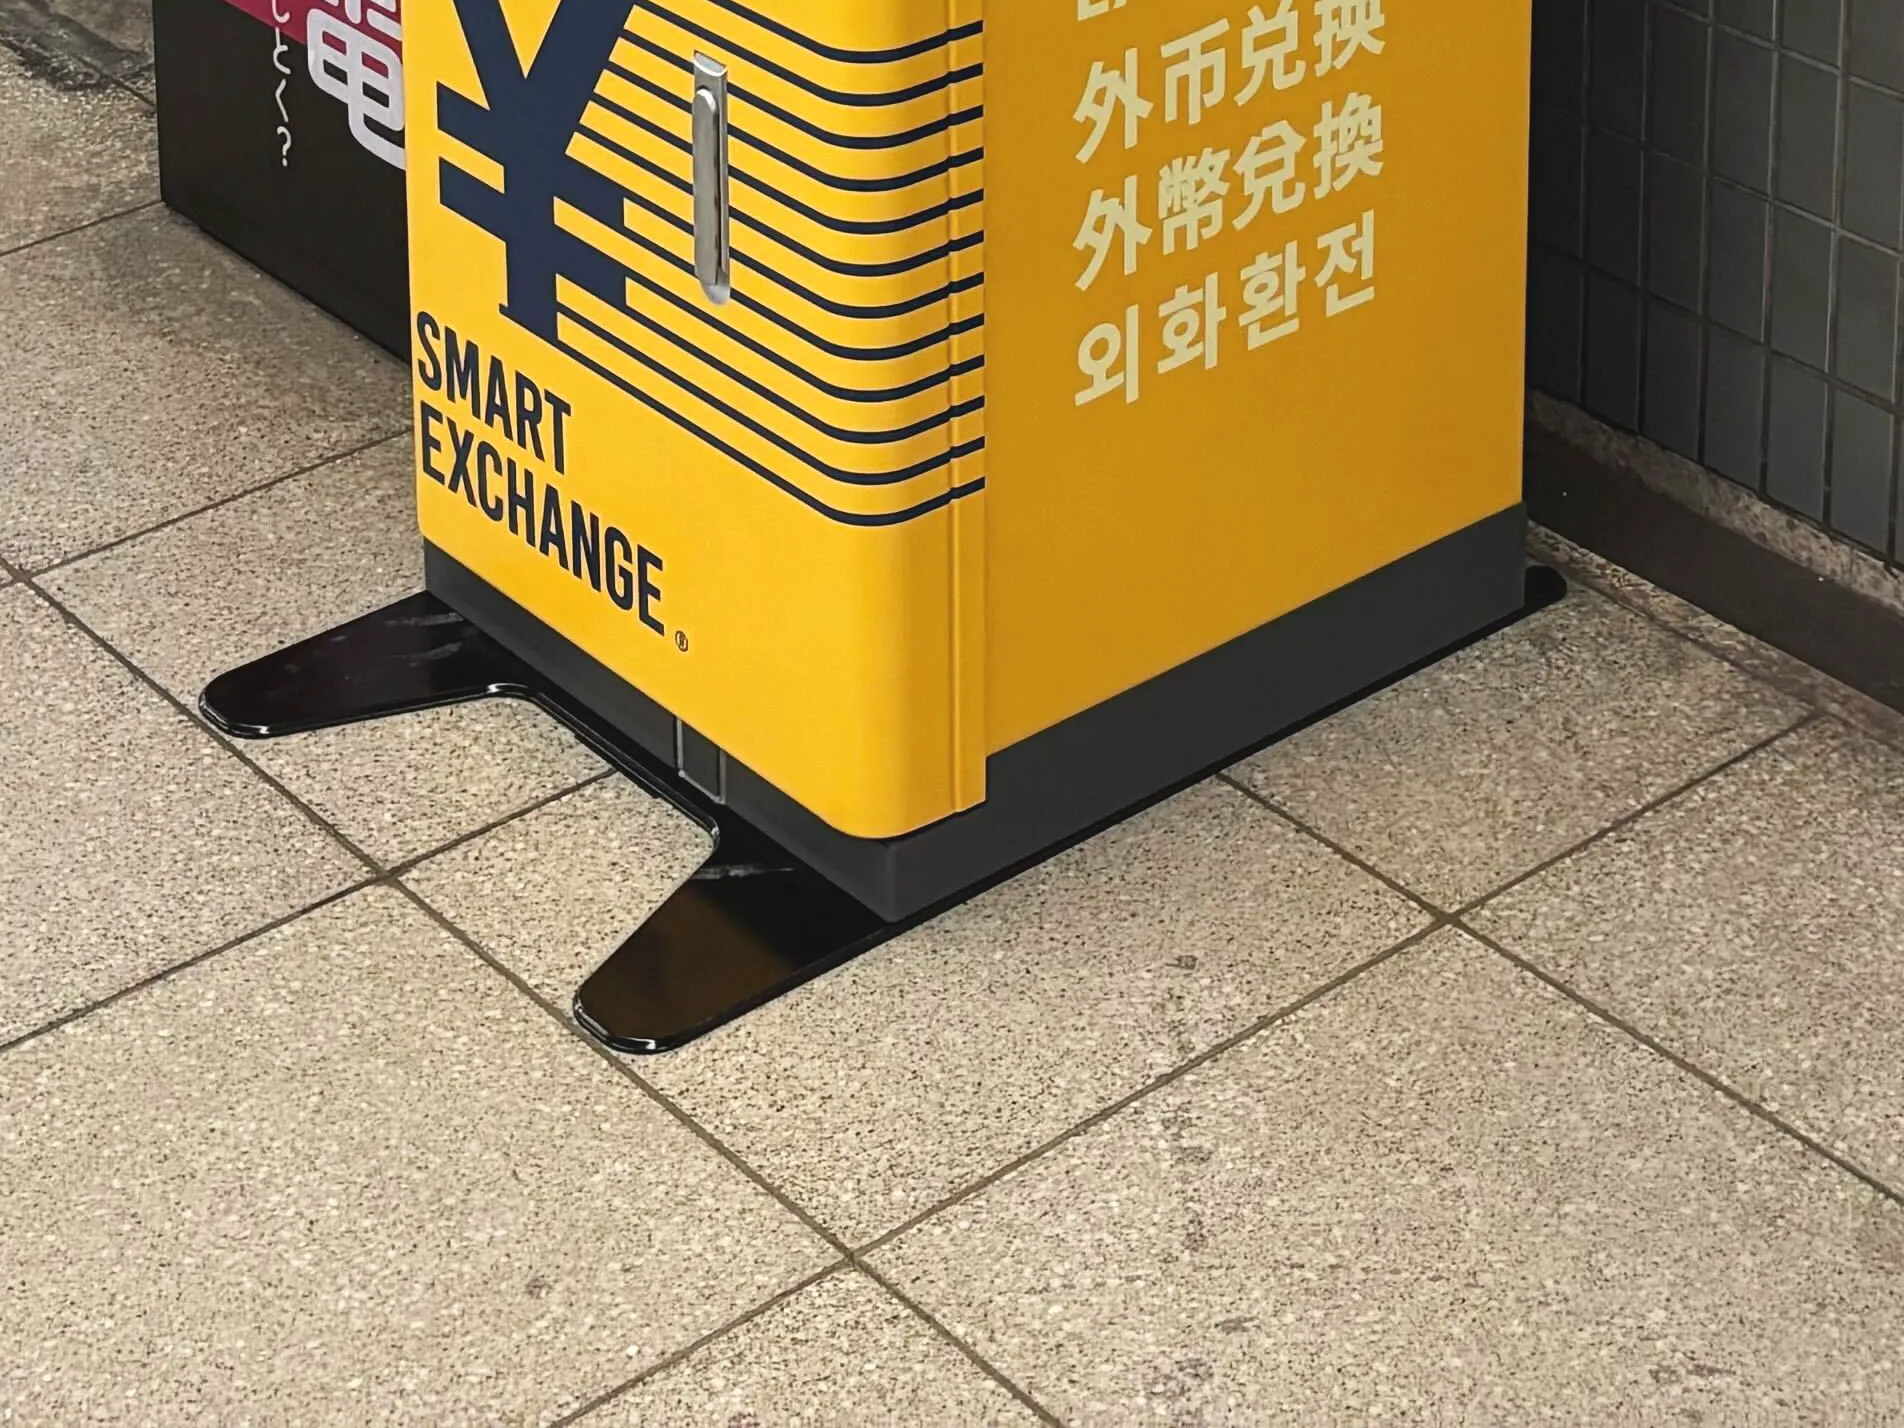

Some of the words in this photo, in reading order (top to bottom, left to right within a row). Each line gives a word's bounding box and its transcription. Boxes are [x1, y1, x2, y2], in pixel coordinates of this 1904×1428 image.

[1073, 92, 1384, 291] 外幣兌換
[416, 310, 571, 476] SMART
[1074, 210, 1377, 407] 외화환전
[419, 399, 665, 636] EXCHANGE
